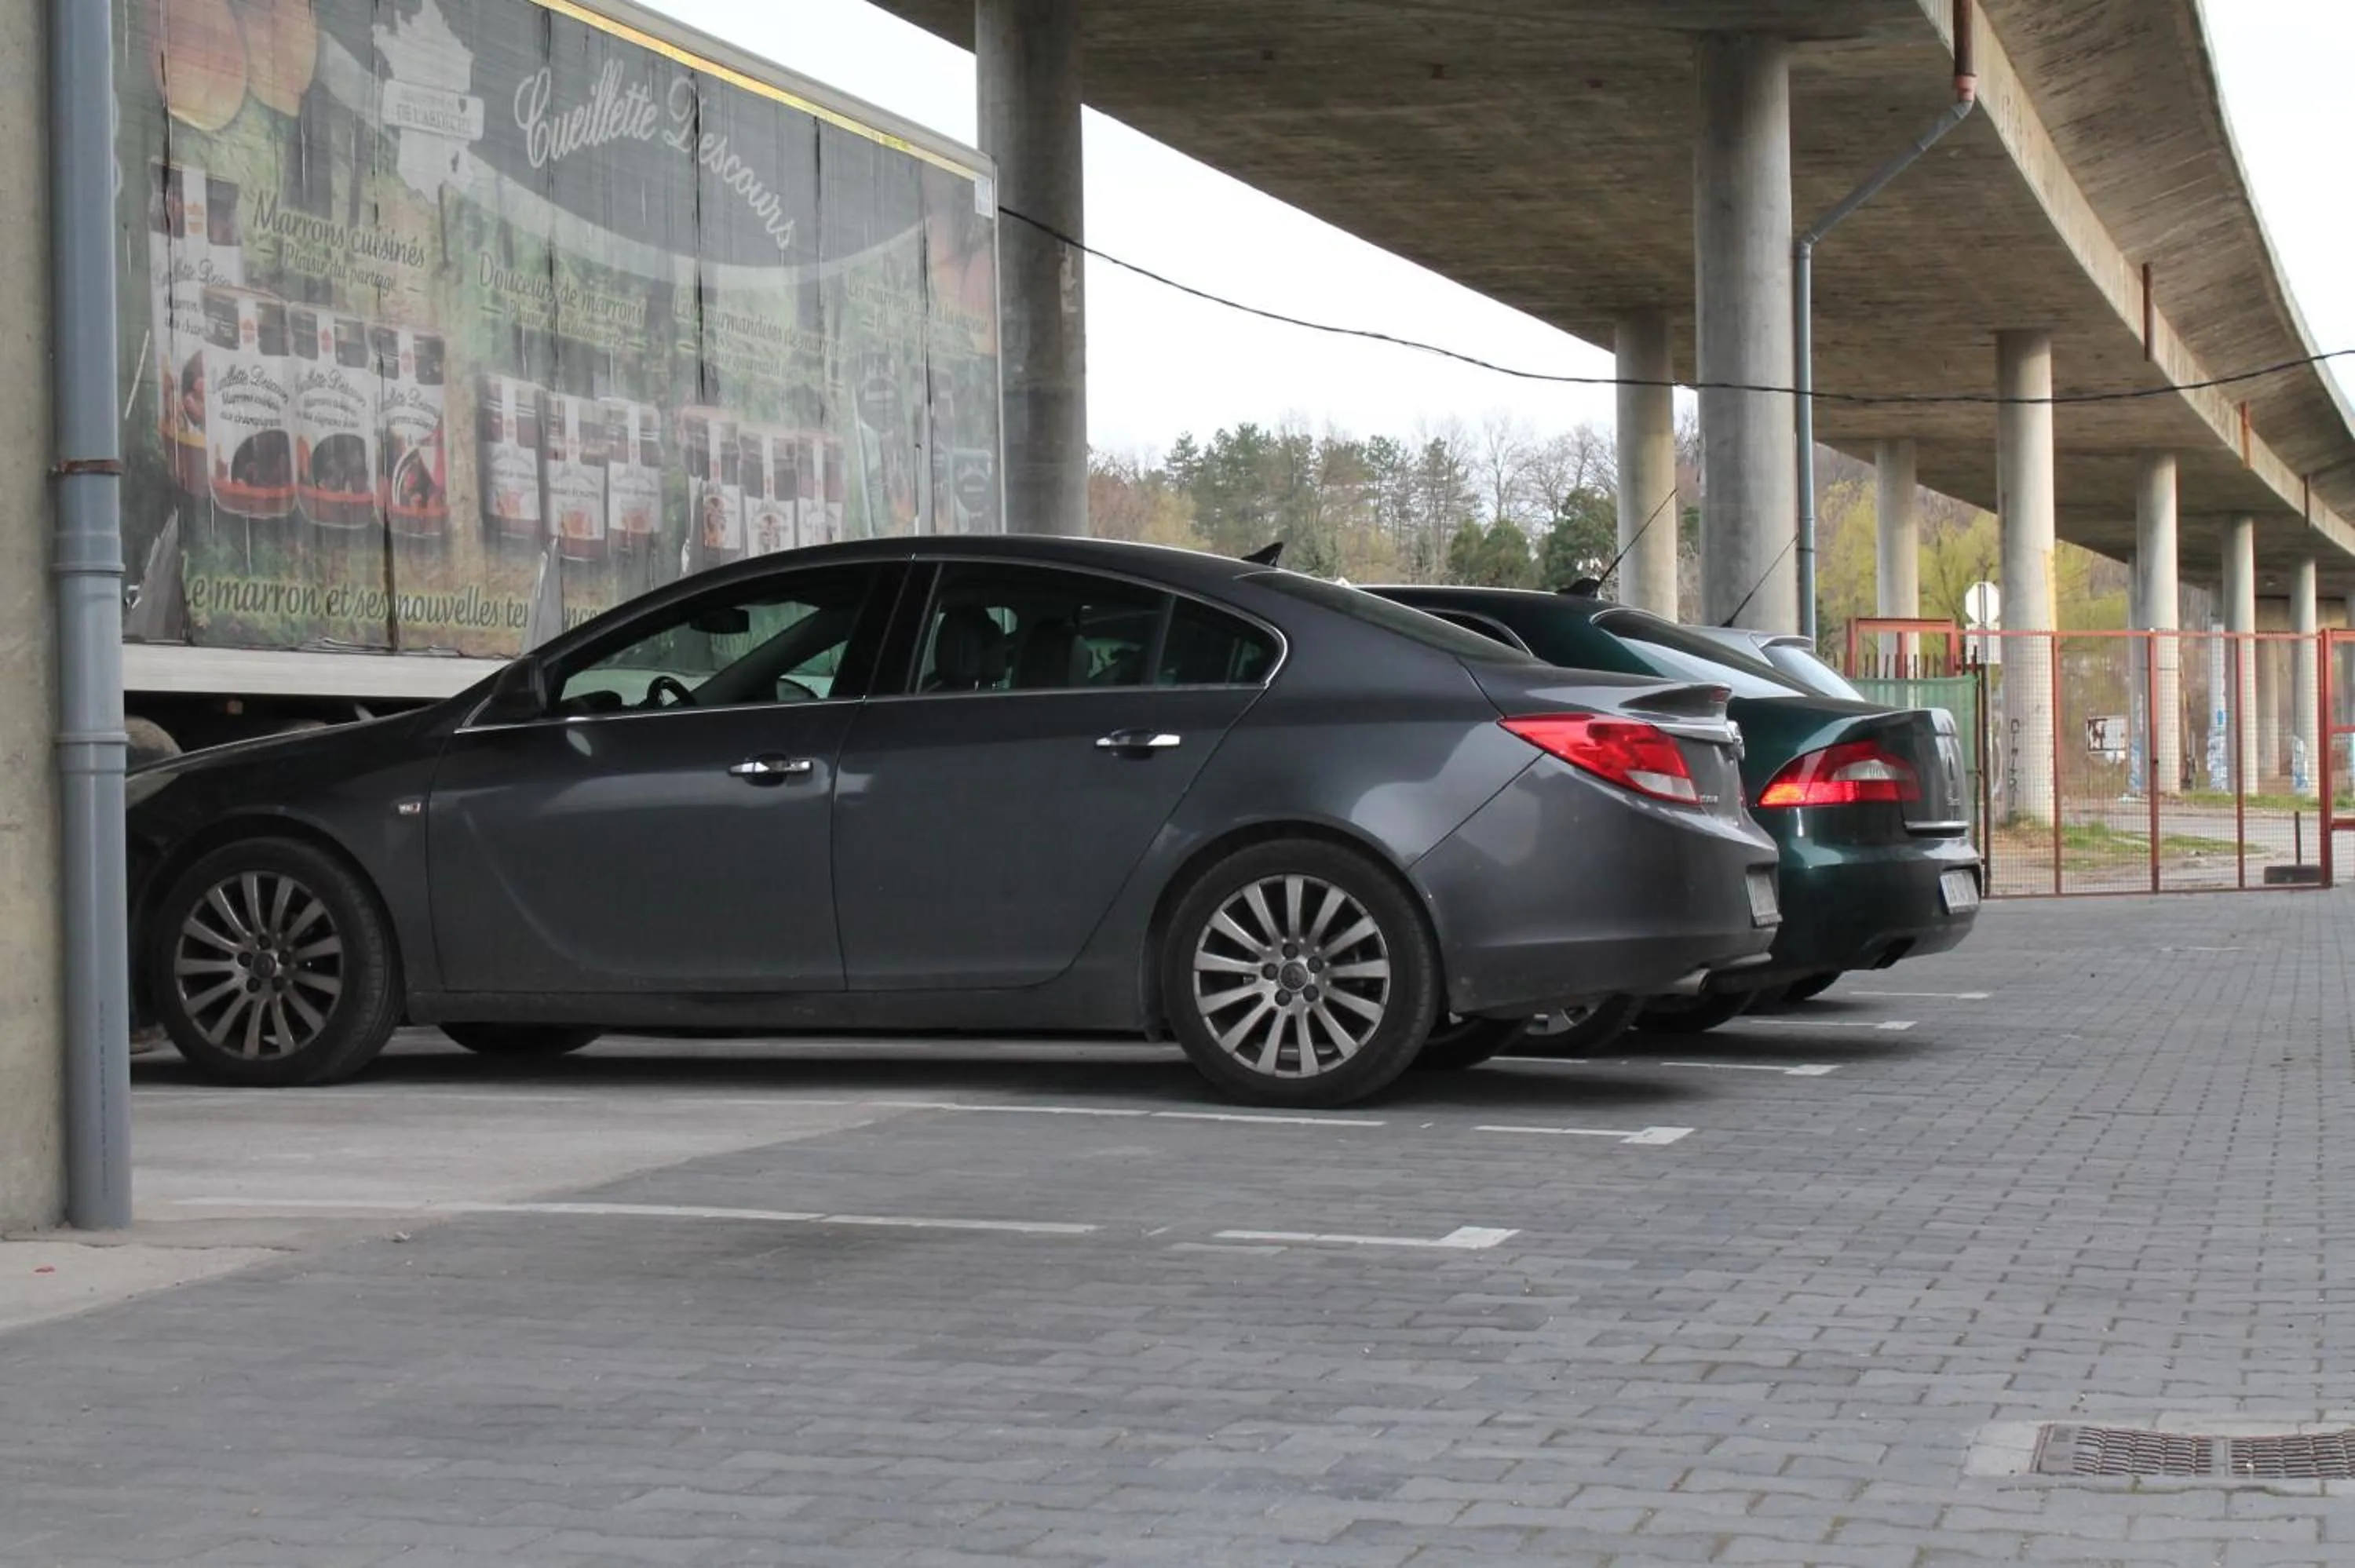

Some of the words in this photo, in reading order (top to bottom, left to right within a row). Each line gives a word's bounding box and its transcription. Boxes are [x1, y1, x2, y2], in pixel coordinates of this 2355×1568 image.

[514, 58, 658, 168] Cueillette
[661, 76, 795, 250] Descours
[253, 190, 345, 249] Marrons
[349, 230, 425, 268] cuisinés
[329, 261, 347, 279] du
[560, 276, 578, 308] de
[214, 579, 320, 615] marron
[326, 588, 350, 618] et
[355, 589, 388, 620] ses
[395, 585, 498, 627] nouvelles
